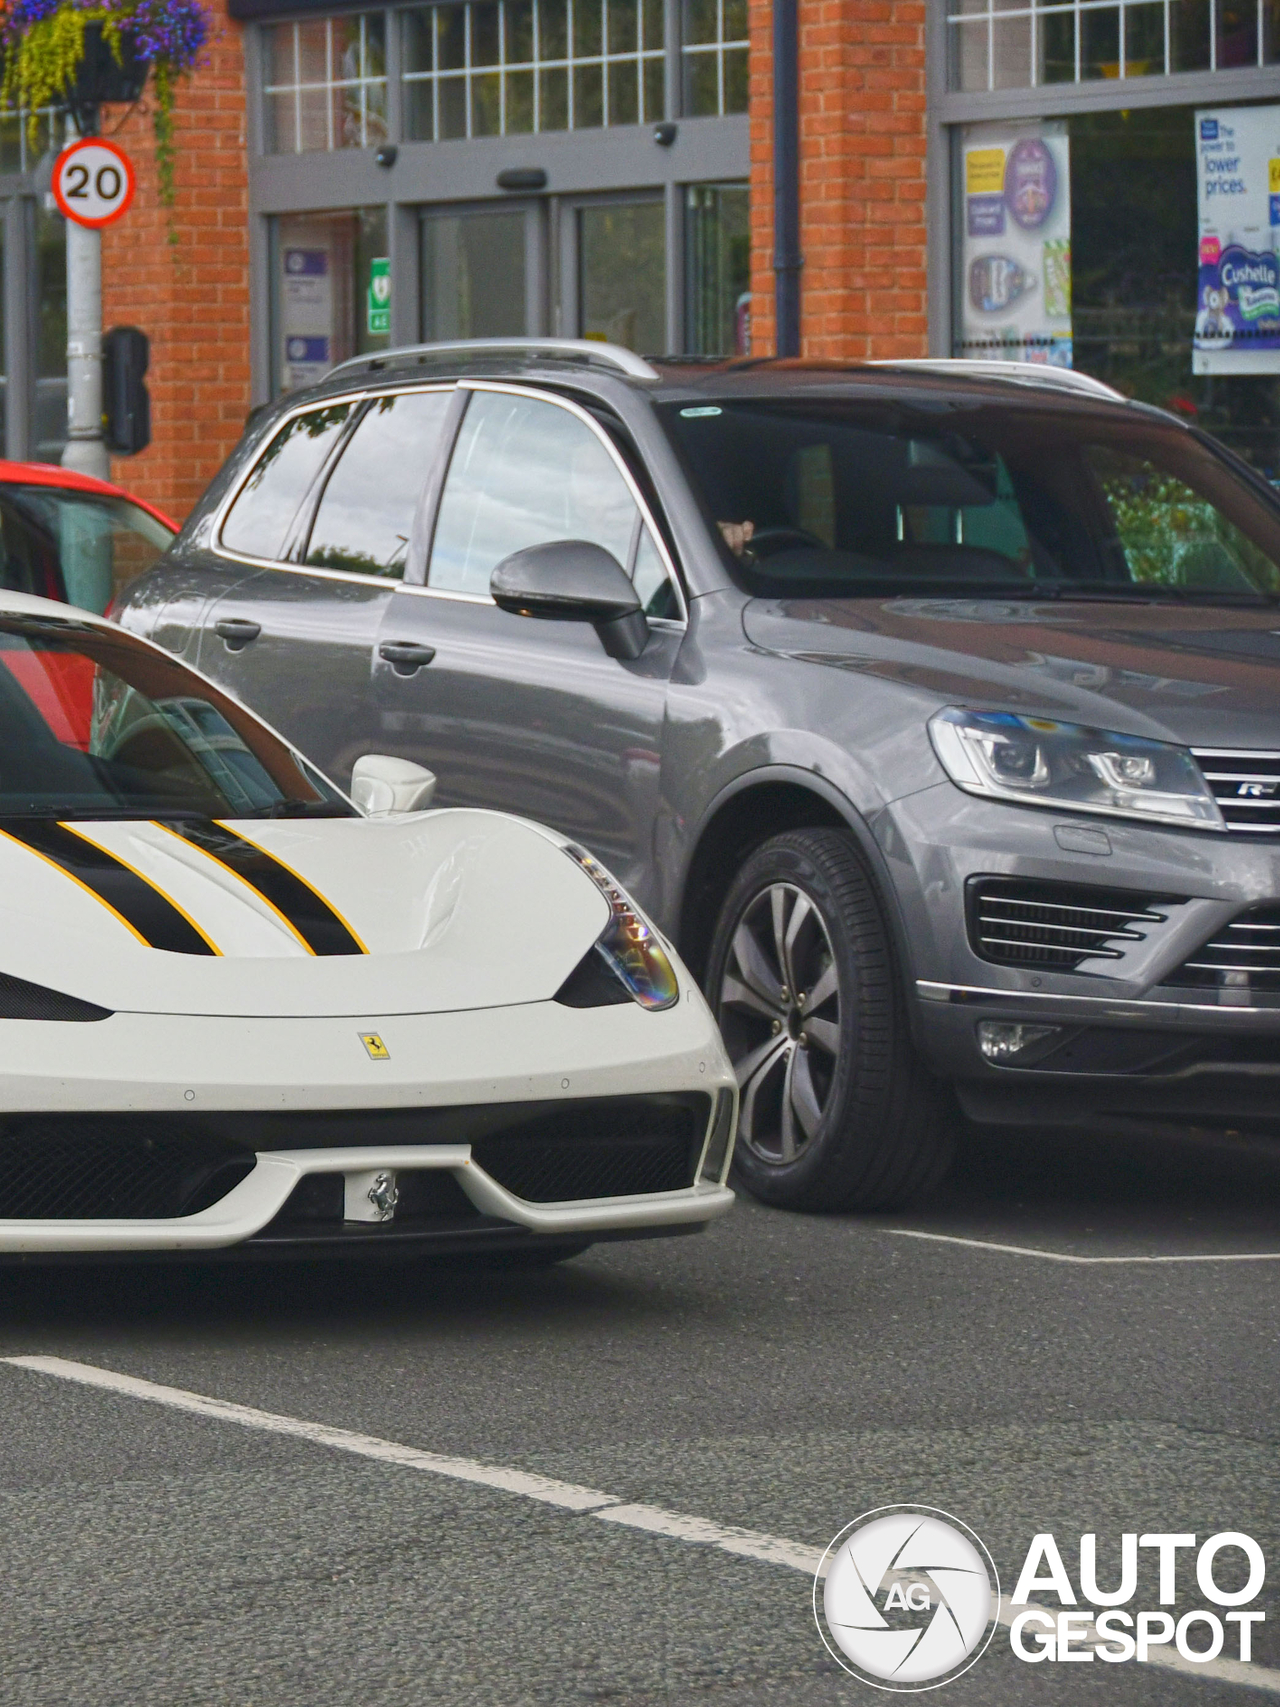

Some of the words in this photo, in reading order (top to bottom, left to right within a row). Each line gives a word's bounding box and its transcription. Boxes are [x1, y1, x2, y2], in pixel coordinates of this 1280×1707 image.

[1205, 155, 1240, 173] lower
[66, 165, 121, 199] 20
[1206, 175, 1247, 200] prices.
[1221, 263, 1276, 286] Cushelle
